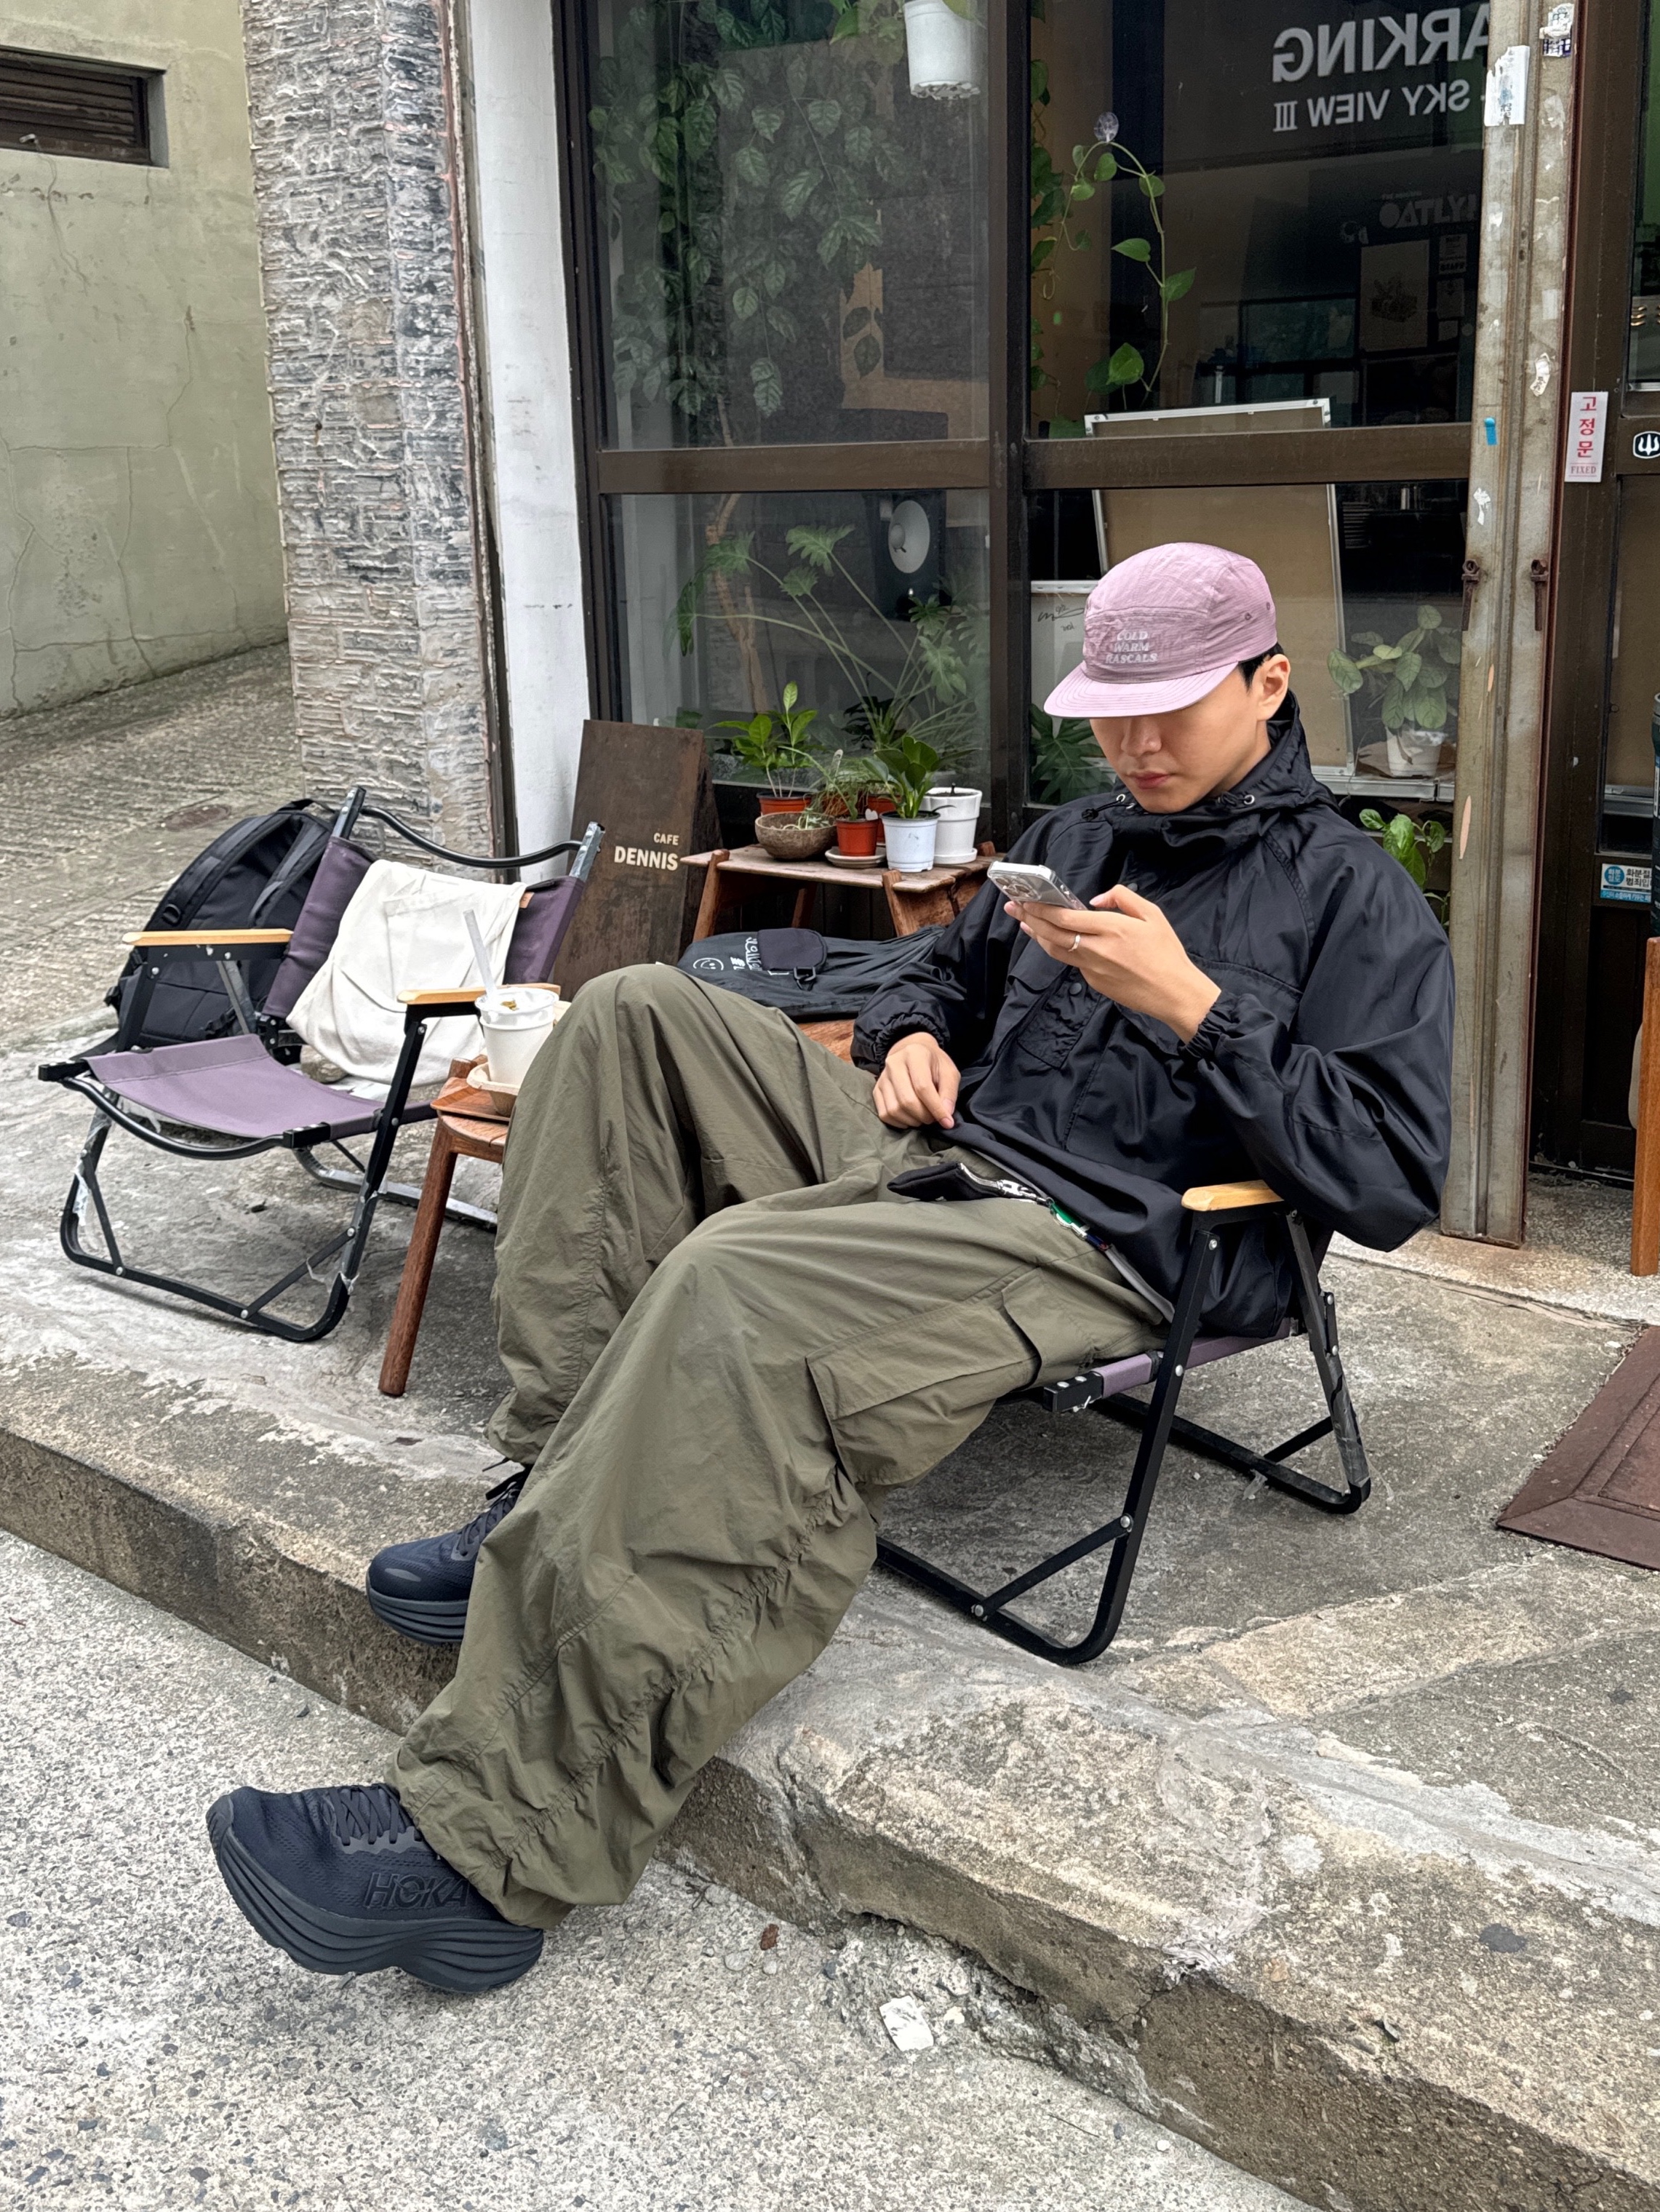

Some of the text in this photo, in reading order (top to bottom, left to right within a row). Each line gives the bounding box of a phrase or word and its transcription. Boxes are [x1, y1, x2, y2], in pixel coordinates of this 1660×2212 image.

[1577, 396, 1597, 458] 고정문
[1571, 466, 1597, 474] FIXED
[1117, 629, 1149, 640] COLD
[1114, 642, 1149, 652] WARM
[1105, 653, 1158, 664] RASCALS
[653, 832, 679, 846] CAFE
[614, 845, 679, 871] DENNIS
[364, 1872, 470, 1909] HOKA
